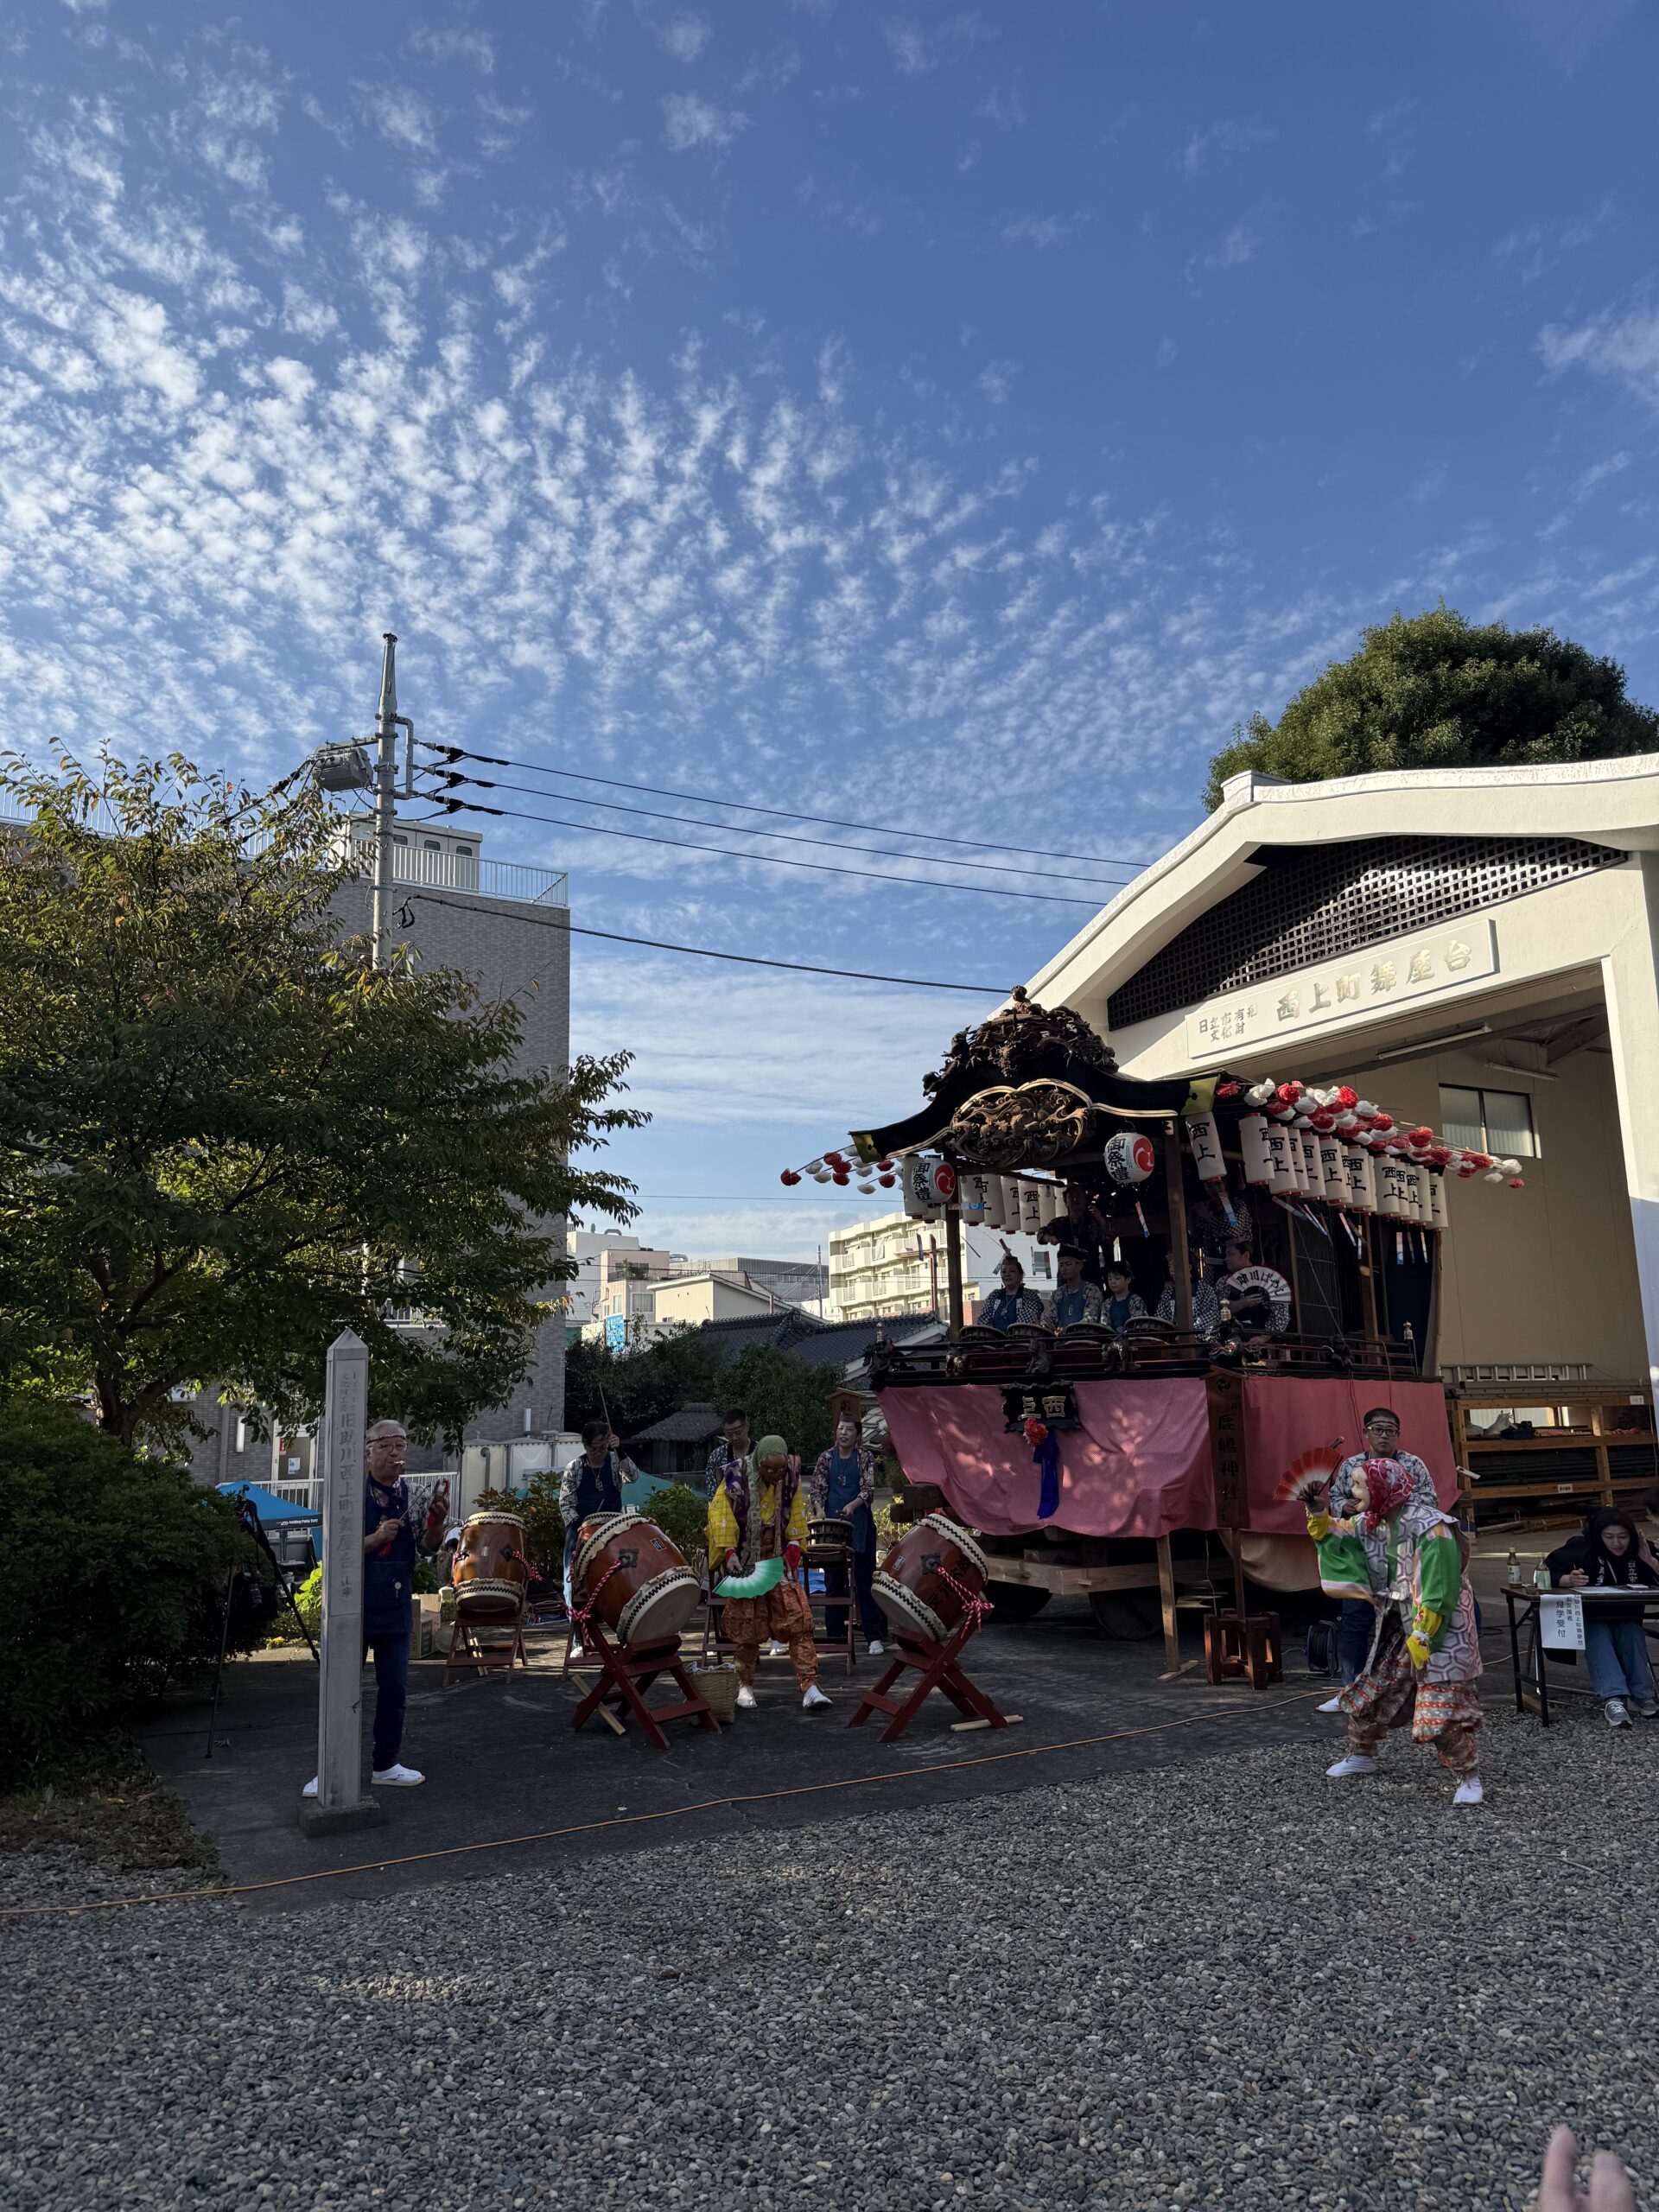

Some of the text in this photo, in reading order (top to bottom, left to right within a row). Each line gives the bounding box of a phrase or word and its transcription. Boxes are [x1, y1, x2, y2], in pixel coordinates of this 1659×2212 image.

[1211, 1020, 1245, 1042] 文化財
[1190, 1122, 1215, 1162] 西上
[1270, 1136, 1288, 1173] 西上
[1320, 1148, 1342, 1183] 西上
[1350, 1158, 1367, 1191] 西上
[1382, 1166, 1398, 1198] 西上
[1396, 1170, 1408, 1201] 西上
[1407, 1174, 1420, 1204] 西上
[1024, 1190, 1040, 1220] 西上
[1555, 1600, 1566, 1637] 見学受付
